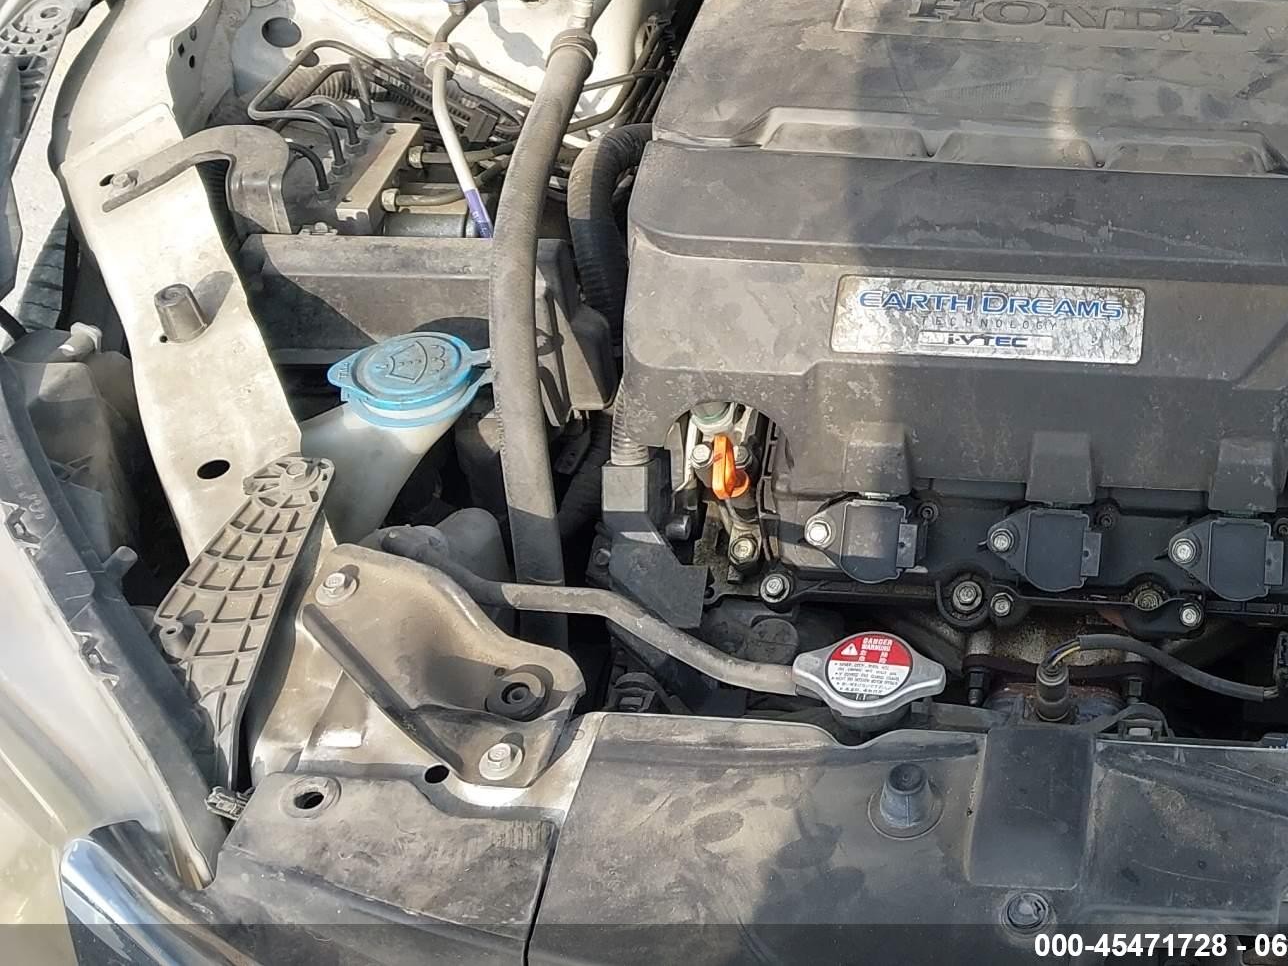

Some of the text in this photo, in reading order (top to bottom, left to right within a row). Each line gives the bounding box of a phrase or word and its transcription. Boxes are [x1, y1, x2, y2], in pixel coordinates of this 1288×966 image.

[858, 289, 1123, 320] EARTH DREAMS
[921, 316, 1057, 331] TECHNOLOGY
[862, 637, 893, 646] DANGER
